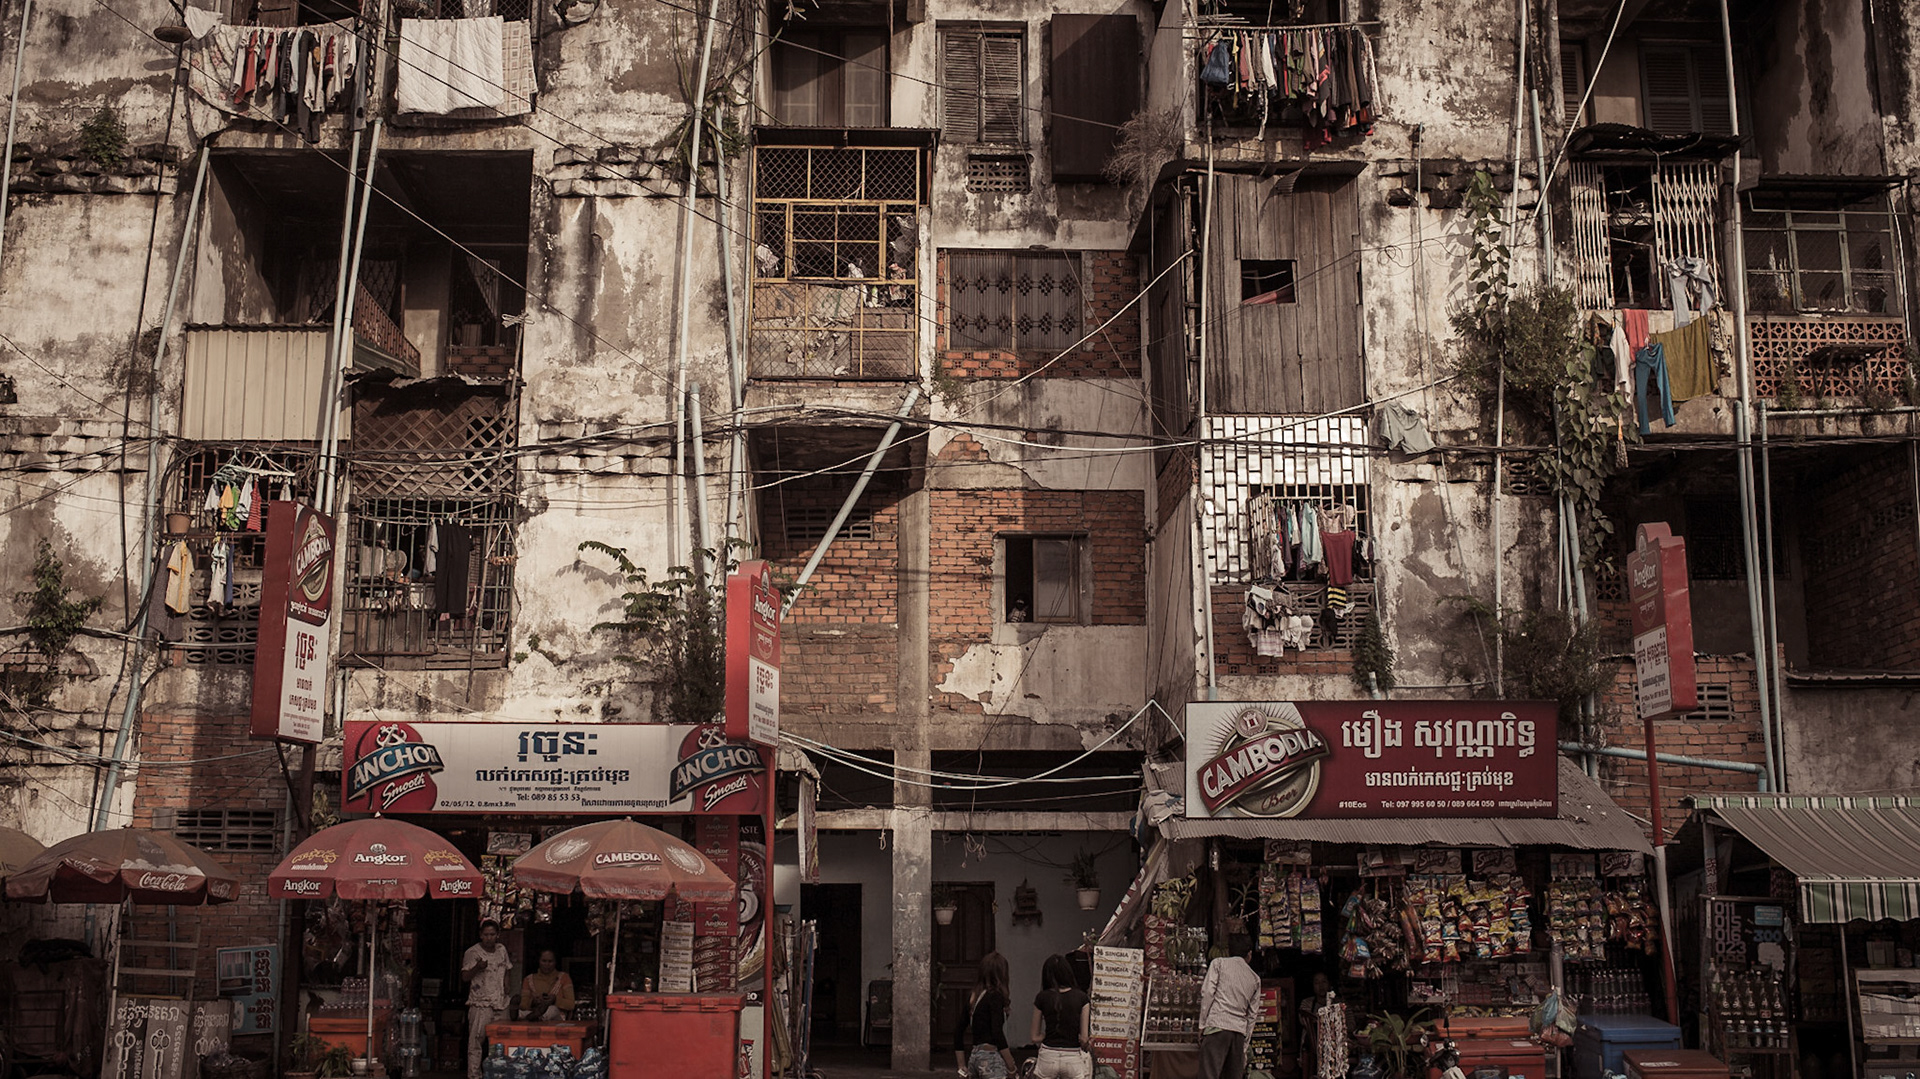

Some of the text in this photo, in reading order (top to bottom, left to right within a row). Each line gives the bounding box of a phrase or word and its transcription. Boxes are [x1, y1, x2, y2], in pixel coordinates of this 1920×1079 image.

[1633, 563, 1657, 589] Angkor
[754, 594, 776, 622] Angkor
[353, 745, 440, 790] ANCHOR
[676, 748, 760, 791] ANCHOR
[1202, 729, 1323, 798] CAMBODIA
[382, 772, 425, 807] Smooth
[704, 774, 747, 809] Smooth
[517, 793, 581, 801] Tel: 089 85 53 53
[1261, 788, 1298, 811] Beer
[739, 825, 760, 834] ASTE
[595, 851, 662, 864] CAMBODIA
[705, 847, 730, 856] Angkor
[353, 853, 407, 865] Angkor
[139, 871, 188, 892] Coca-Cola
[283, 879, 321, 894] Angkor
[439, 879, 472, 894] Angkor
[1714, 901, 1736, 915] 011
[704, 920, 729, 928] Angkor
[1714, 914, 1742, 929] 015
[1715, 927, 1742, 941] 016
[1753, 929, 1783, 942] 300
[1715, 940, 1747, 954] 023
[1103, 980, 1128, 988] SINGHA
[1102, 1010, 1126, 1018] SINGHA
[1101, 1025, 1125, 1034] SINGHA
